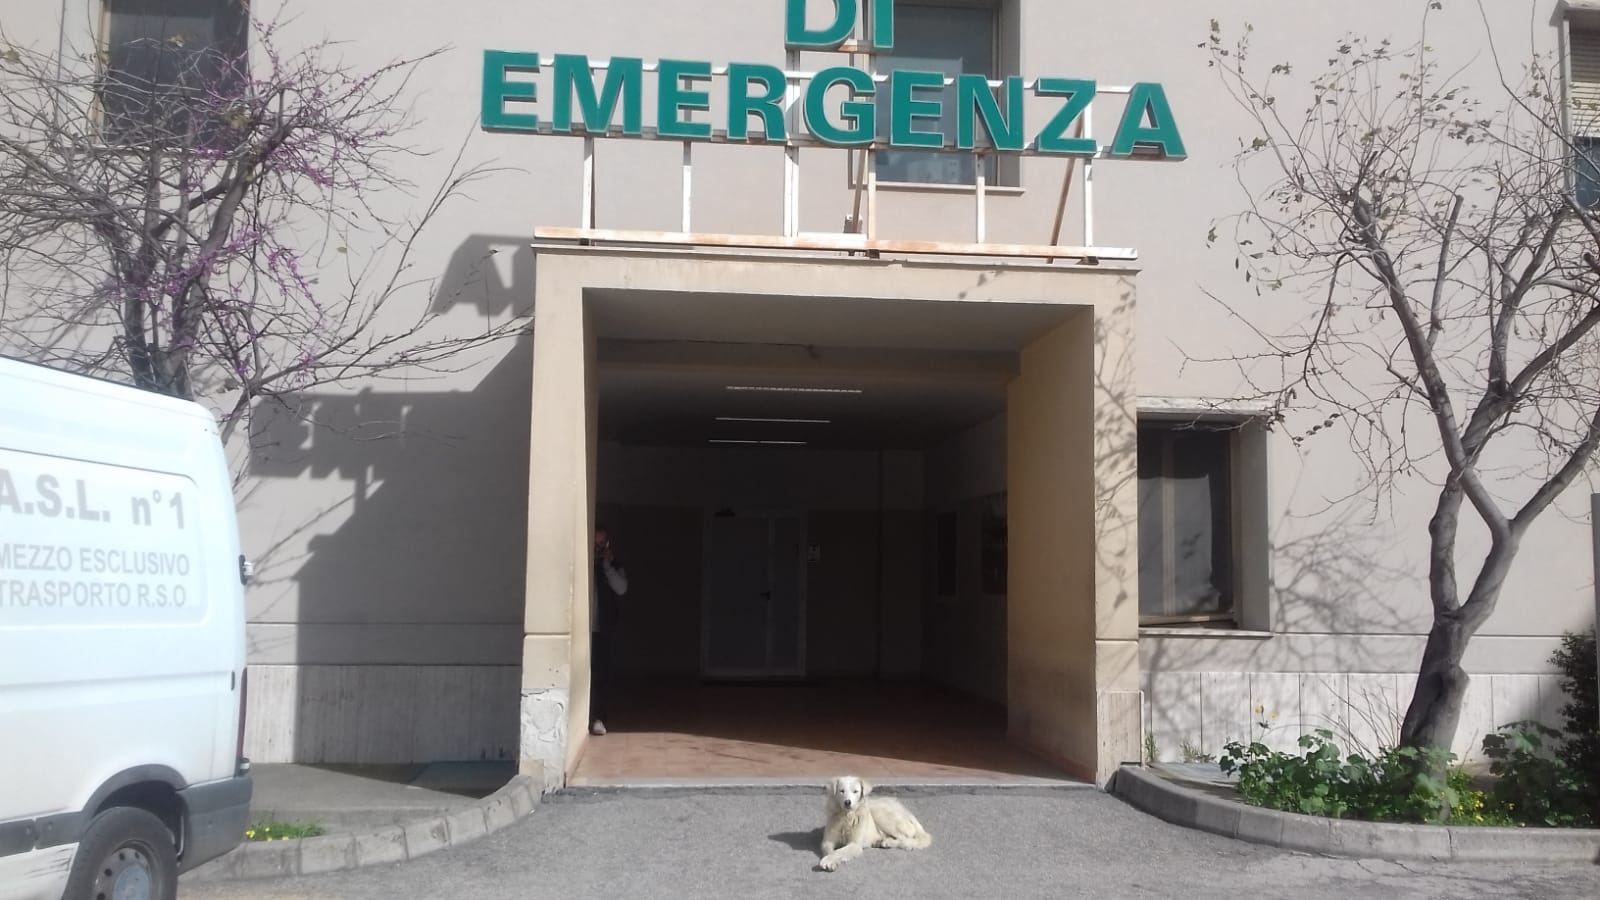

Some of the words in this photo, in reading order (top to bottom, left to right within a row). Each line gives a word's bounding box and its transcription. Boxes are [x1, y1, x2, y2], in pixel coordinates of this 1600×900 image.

[785, 0, 894, 50] DI
[481, 49, 1188, 160] EMERGENZA
[0, 468, 111, 522] A.S.L.
[79, 547, 190, 577] ESCLUSIVO
